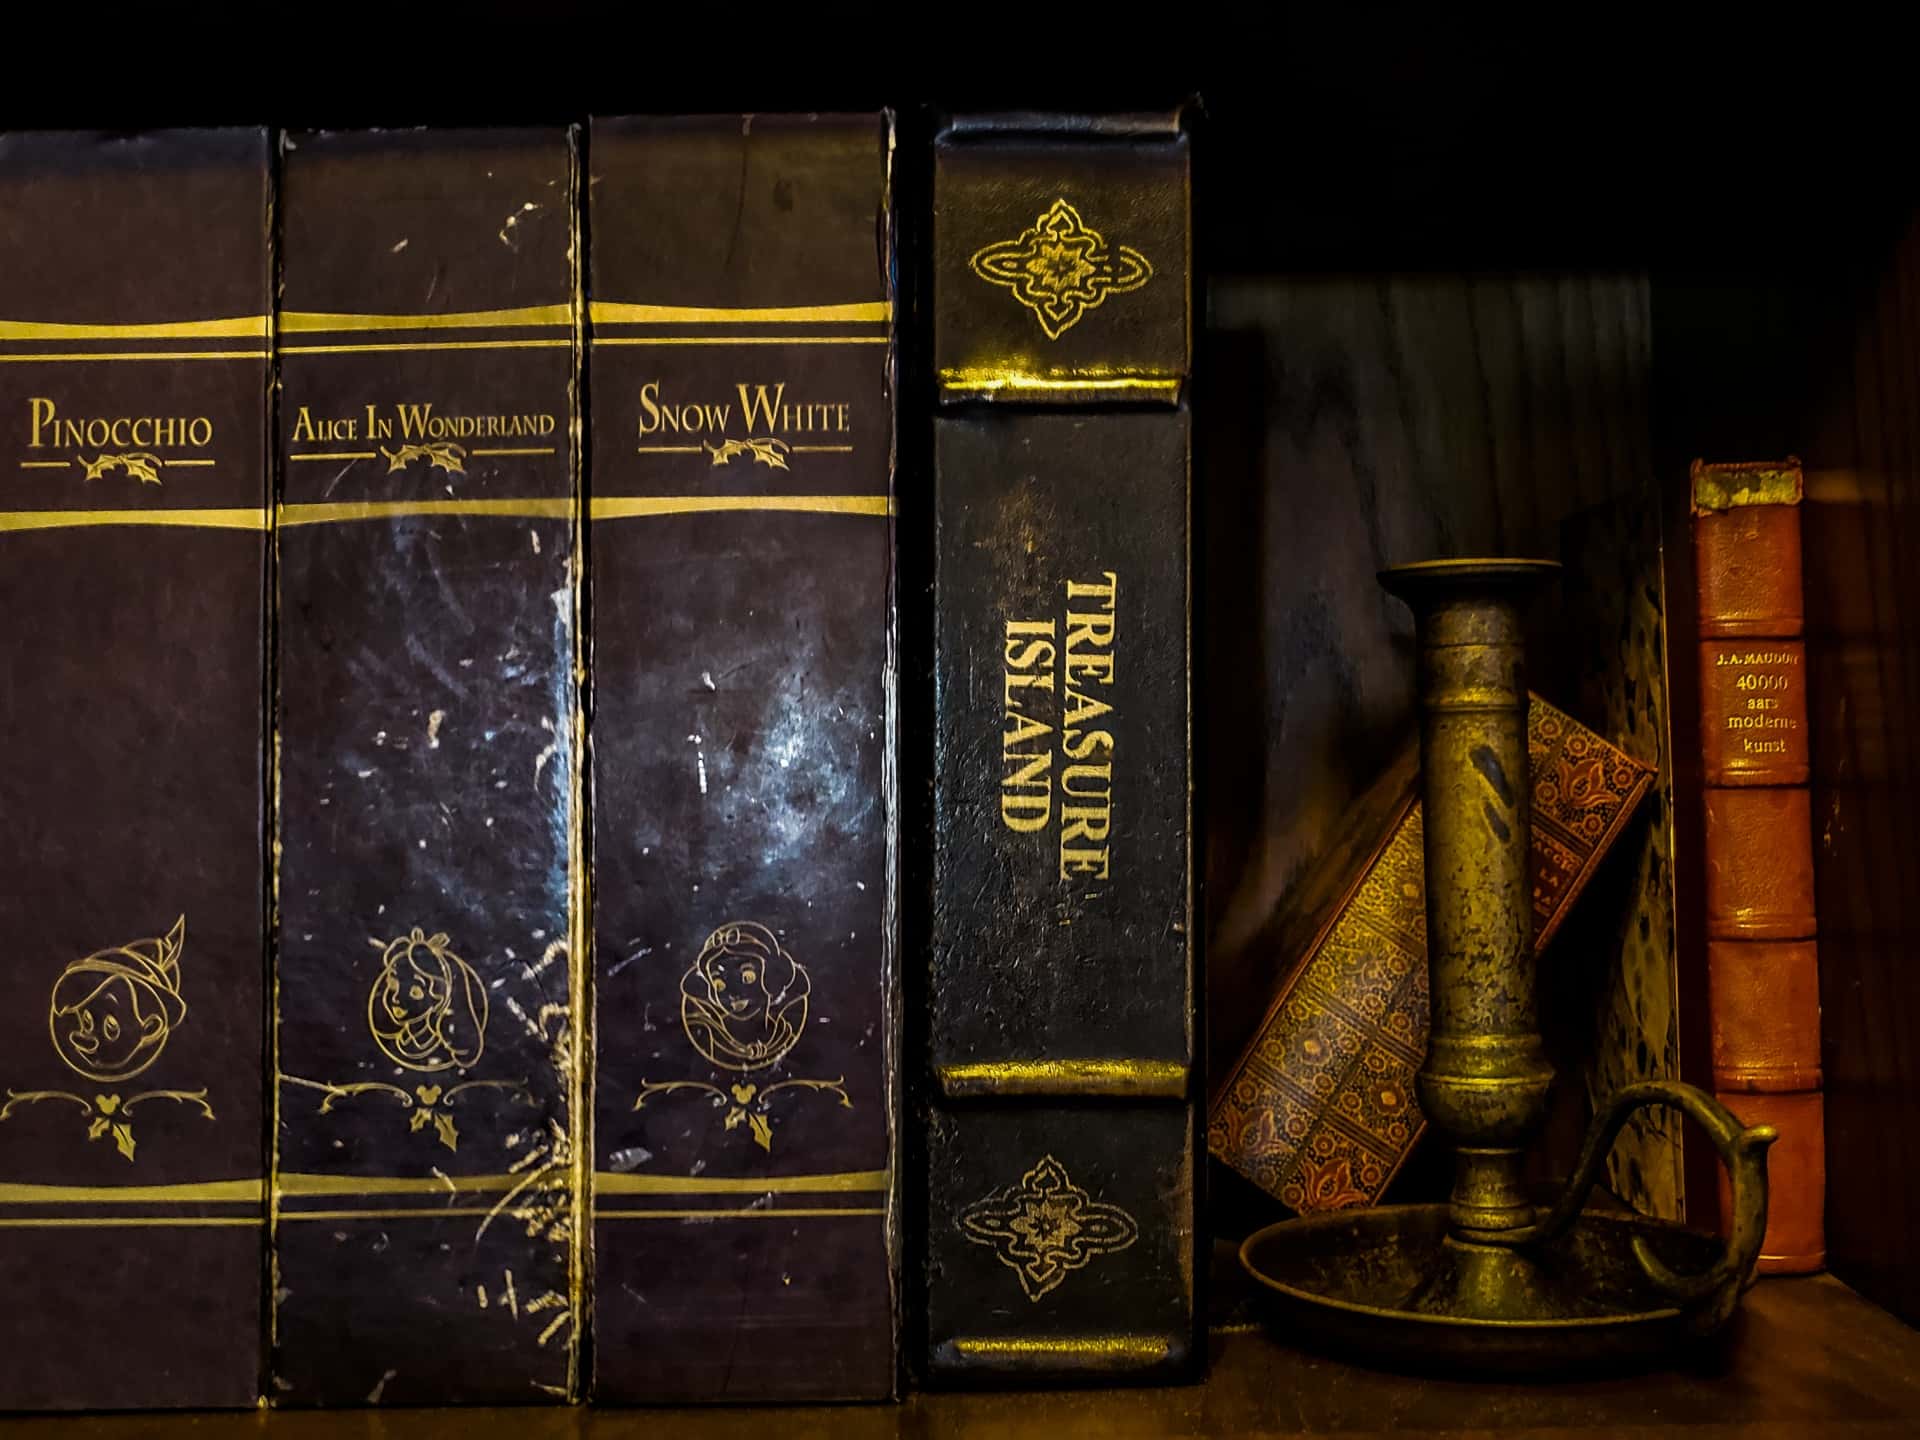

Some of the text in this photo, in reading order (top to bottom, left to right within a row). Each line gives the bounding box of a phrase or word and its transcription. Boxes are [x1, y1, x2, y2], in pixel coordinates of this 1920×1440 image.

[27, 397, 213, 448] PINOCCHIO
[292, 402, 556, 442] ALICE IN WONDERLAND
[638, 379, 850, 438] SNOW WHITE
[1001, 617, 1056, 833] ISLAND
[1059, 570, 1118, 881] TREASURE
[1744, 737, 1787, 753] kunst
